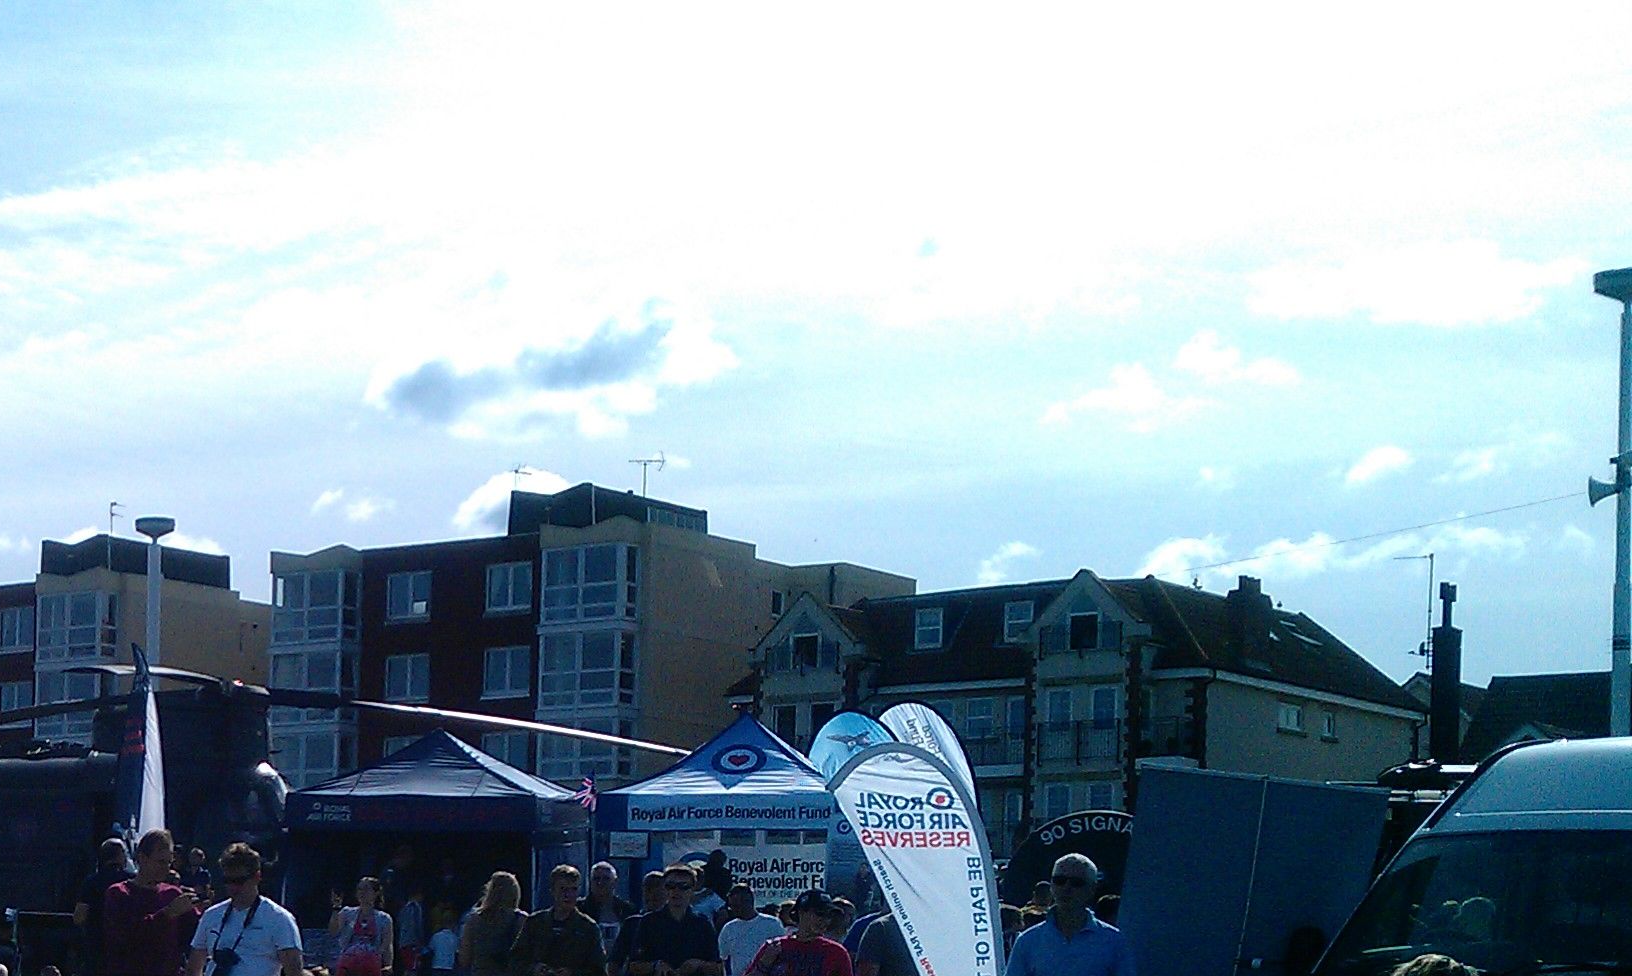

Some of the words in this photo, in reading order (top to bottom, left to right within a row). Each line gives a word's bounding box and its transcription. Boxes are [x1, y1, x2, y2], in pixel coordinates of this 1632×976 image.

[631, 807, 665, 823] Royal
[667, 806, 685, 820] Air
[687, 805, 722, 820] Force
[725, 804, 795, 819] Benevolent
[799, 806, 831, 819] Fund
[1040, 825, 1065, 845] 90
[1069, 816, 1134, 837] SIGNA
[728, 858, 767, 876] Royal
[769, 859, 790, 873] Air
[792, 858, 824, 873] Forc
